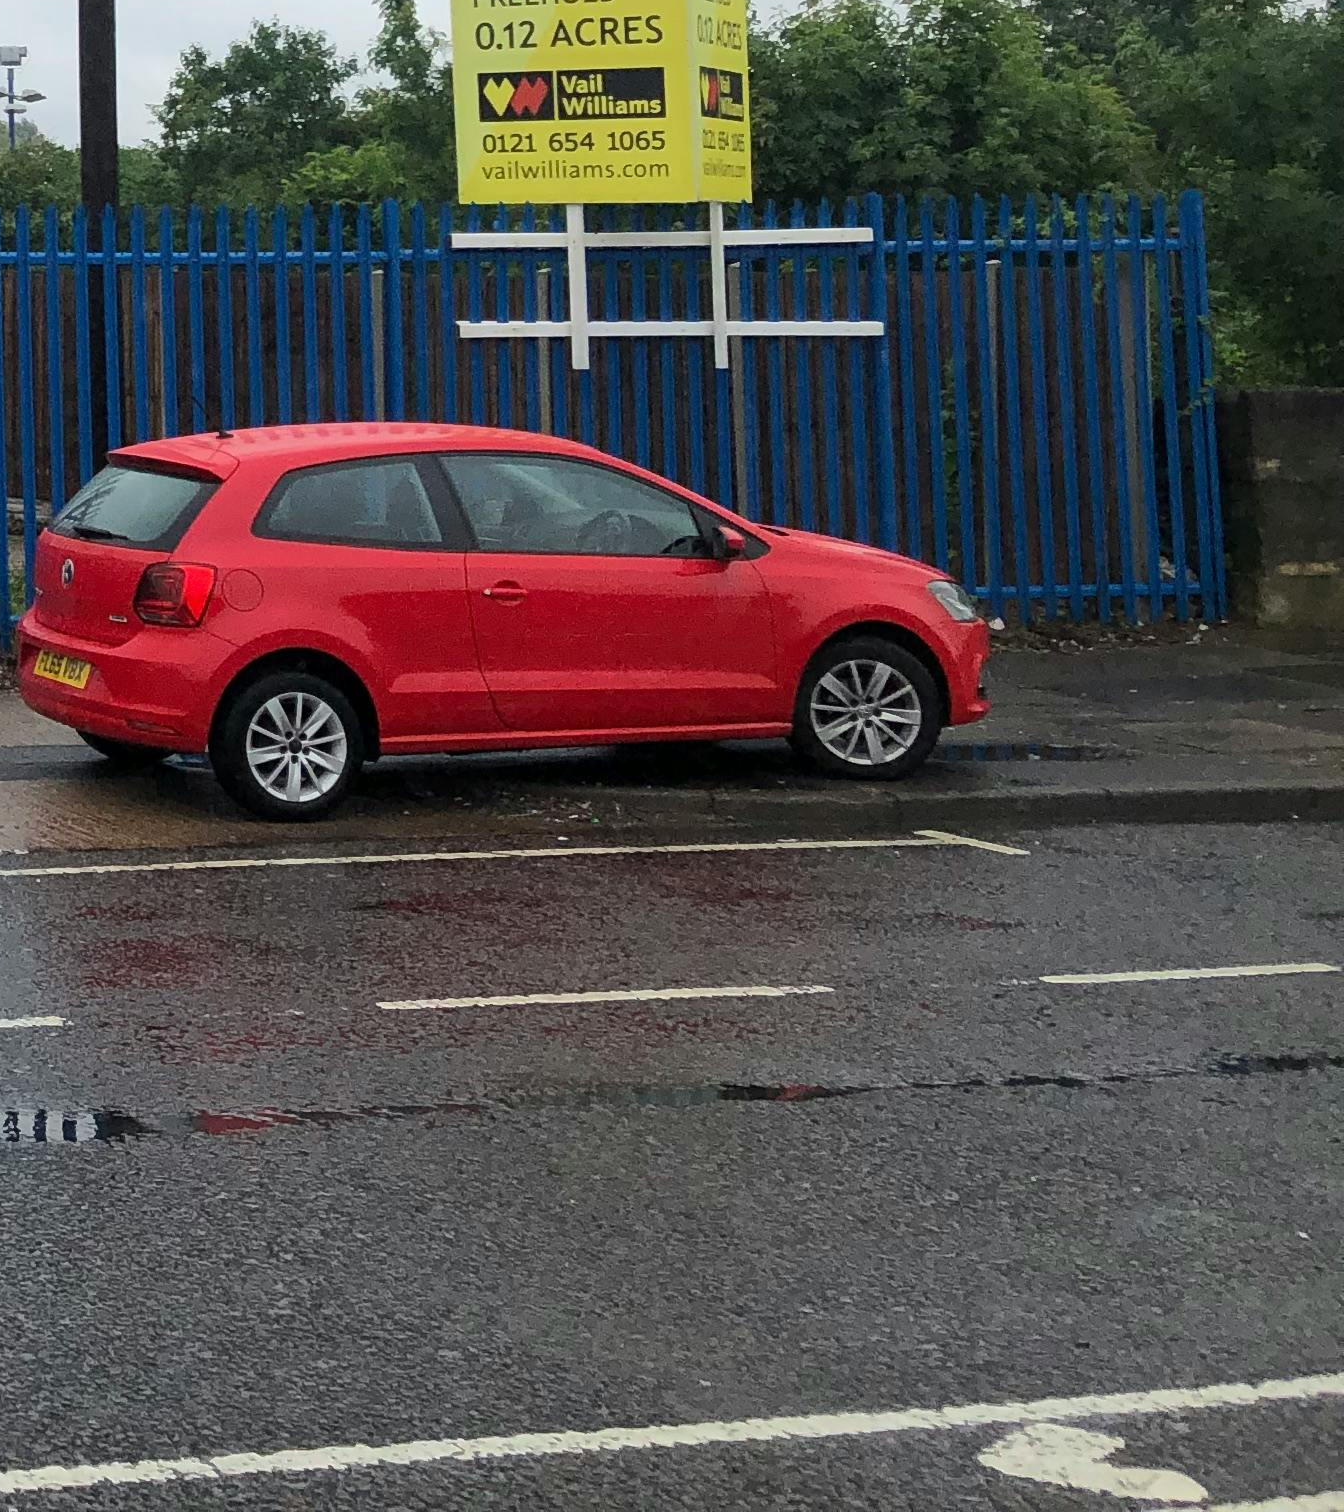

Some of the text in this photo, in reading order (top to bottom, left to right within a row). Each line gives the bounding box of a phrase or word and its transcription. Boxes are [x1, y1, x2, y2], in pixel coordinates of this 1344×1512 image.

[475, 15, 664, 51] 0.12 ACRES
[560, 73, 604, 94] Vail
[562, 95, 662, 116] Williams
[482, 130, 666, 154] 0121 654 1065
[481, 160, 669, 180] vailwilliams.com
